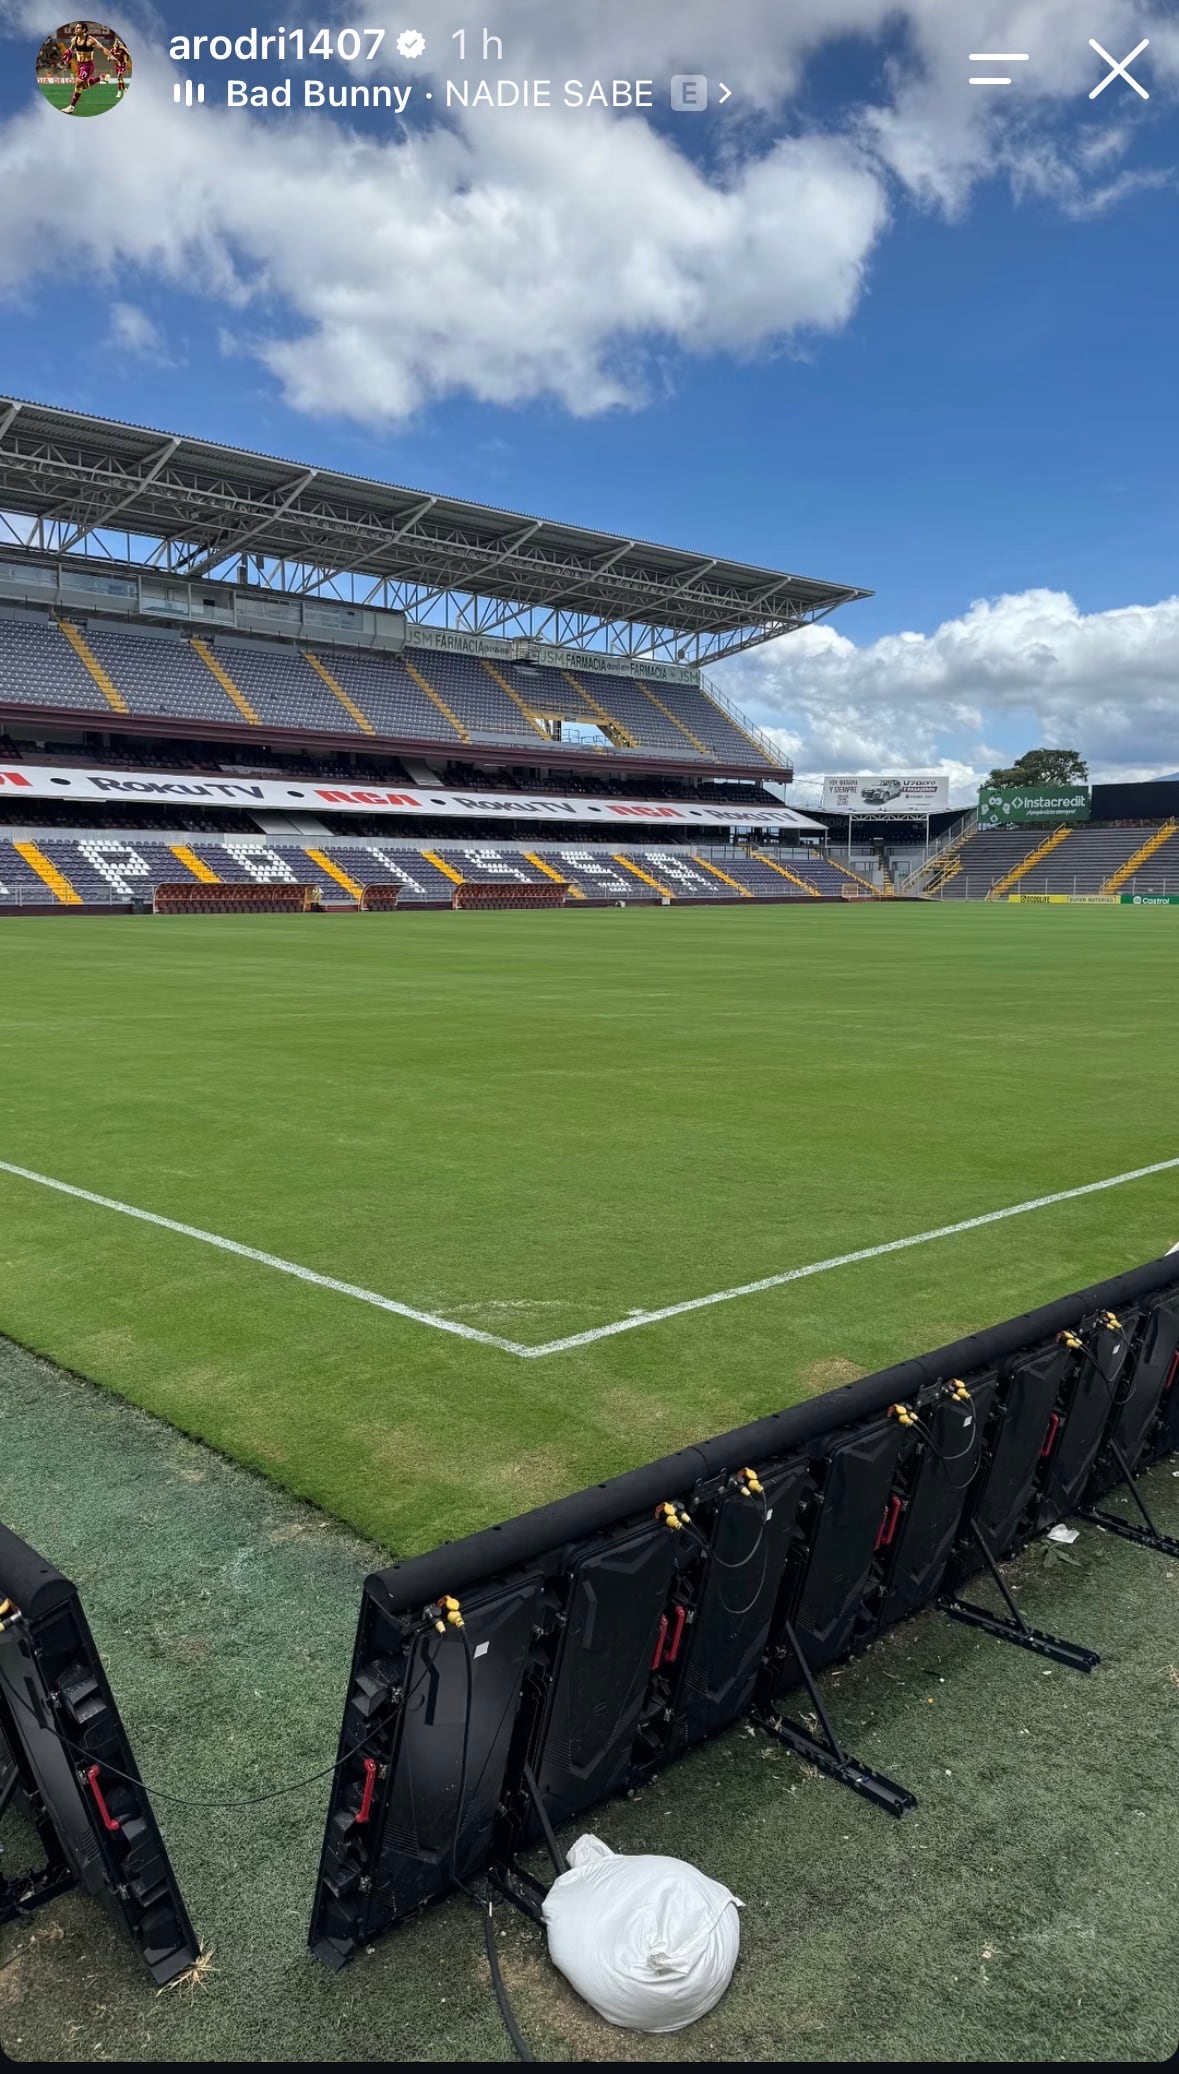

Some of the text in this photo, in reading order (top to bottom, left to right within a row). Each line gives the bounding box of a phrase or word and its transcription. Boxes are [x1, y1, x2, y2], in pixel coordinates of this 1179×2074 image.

[408, 630, 432, 647] JSM
[435, 634, 484, 655] FARMACIA
[540, 649, 564, 665] JSM
[566, 654, 607, 672] FARMACIA
[630, 663, 667, 680] FARMACIA
[677, 669, 699, 683] JSM
[313, 789, 422, 806] RCA
[606, 805, 687, 818] RCA
